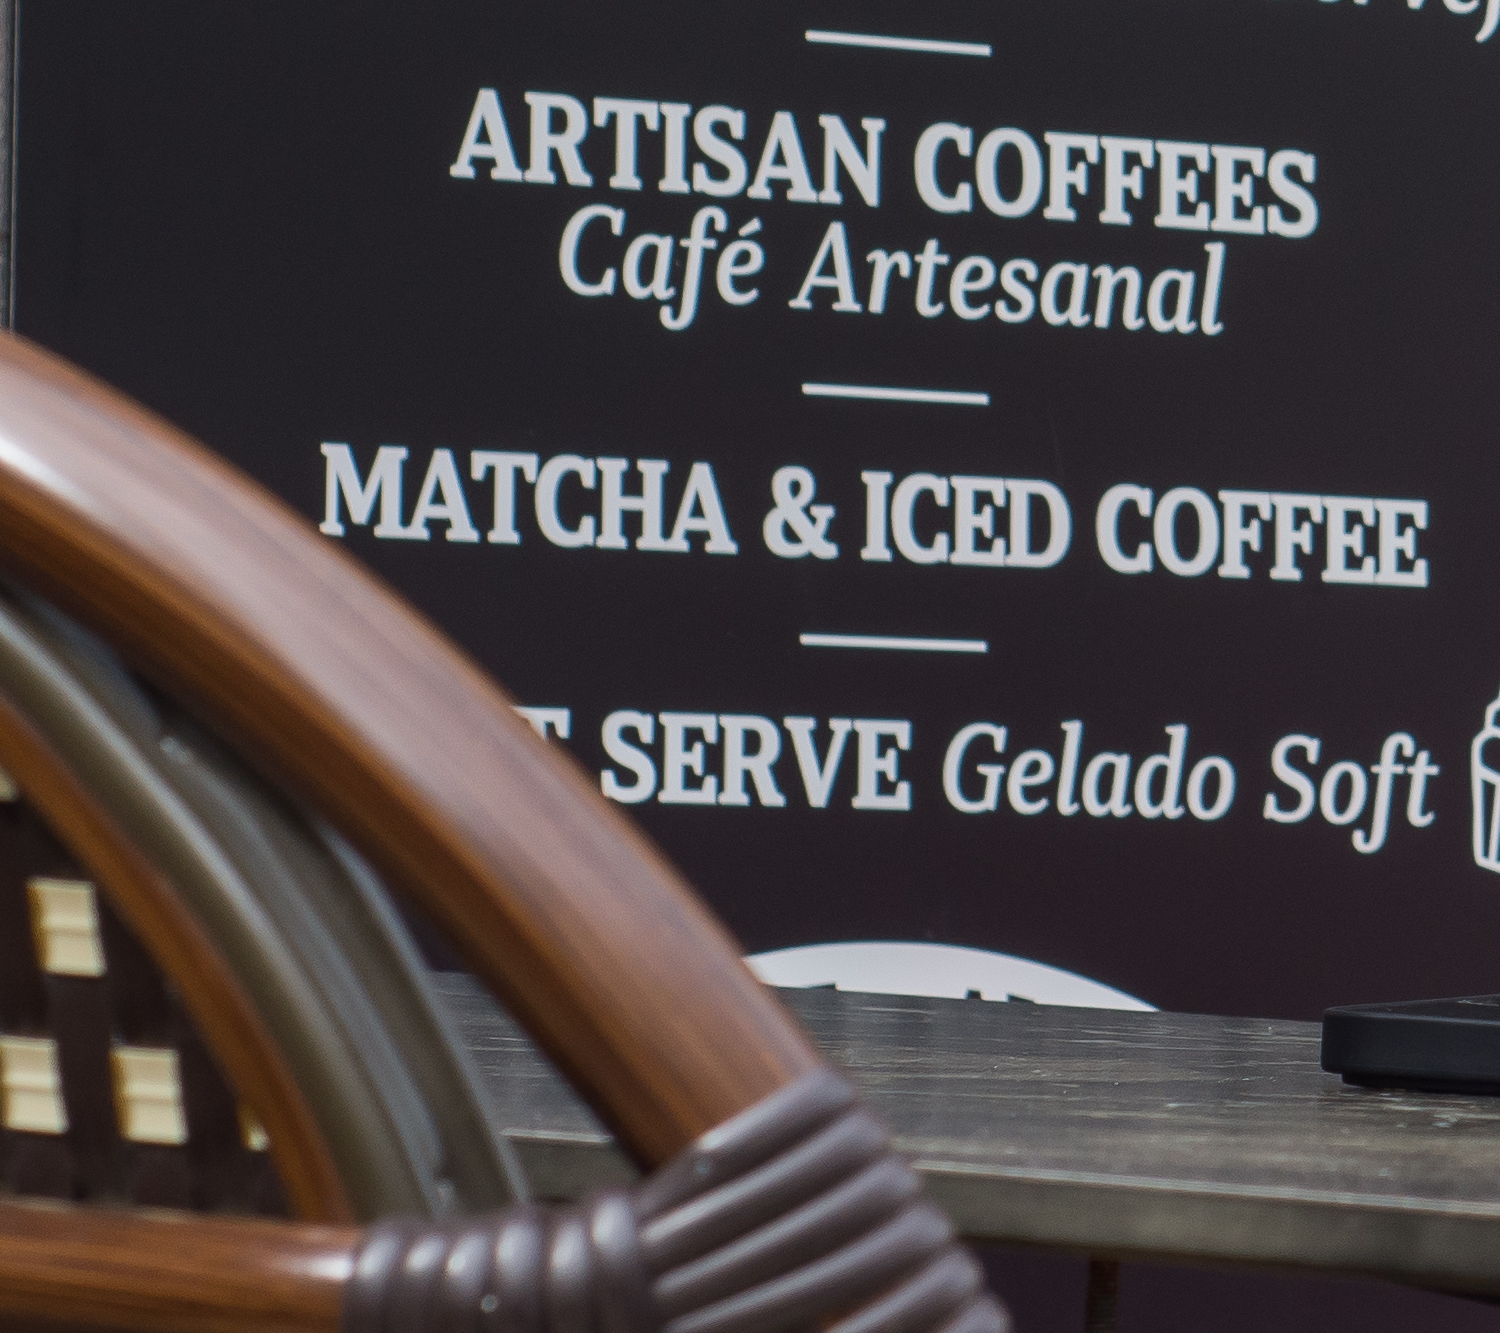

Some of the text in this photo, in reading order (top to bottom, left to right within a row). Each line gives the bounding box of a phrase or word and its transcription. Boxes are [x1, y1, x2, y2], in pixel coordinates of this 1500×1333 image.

[448, 86, 1320, 240] ARTISAN COFFEES
[557, 203, 1226, 337] Café Artesanal
[317, 441, 1430, 589] MATCHA & ICED COFFEE
[599, 708, 1441, 855] SERVE Gelado Soft
